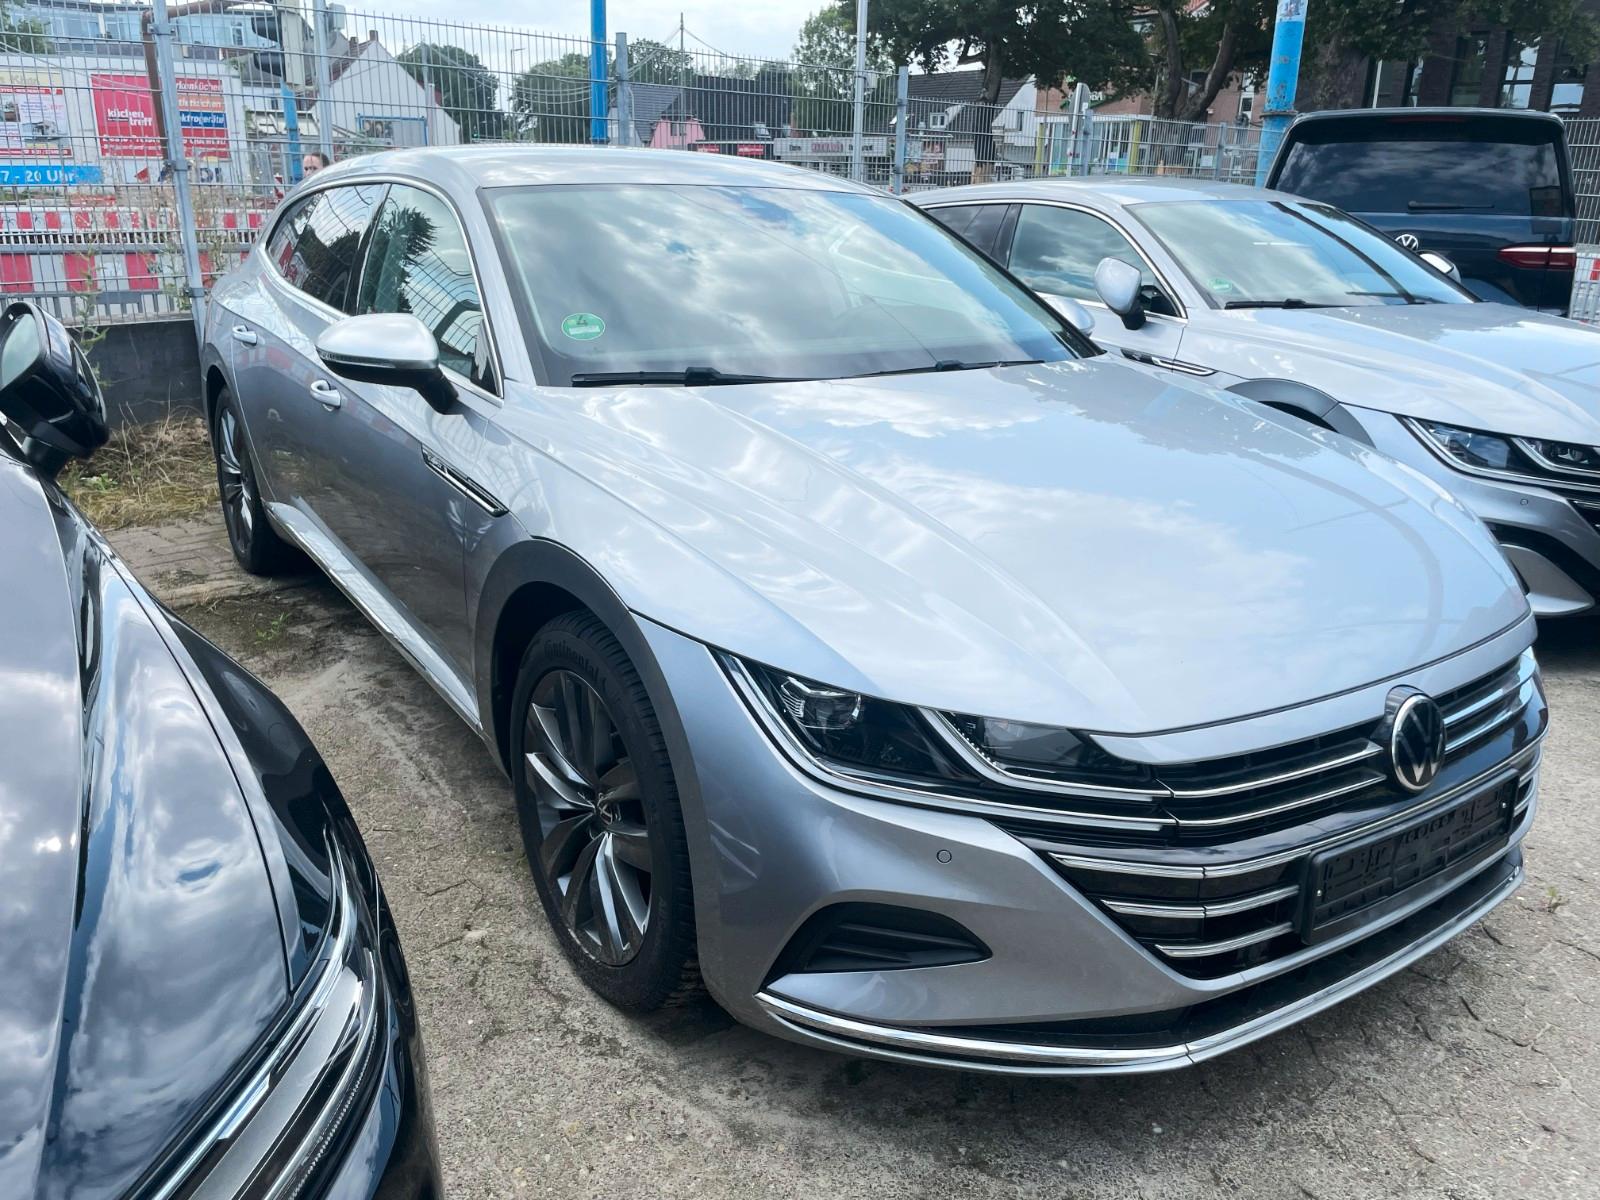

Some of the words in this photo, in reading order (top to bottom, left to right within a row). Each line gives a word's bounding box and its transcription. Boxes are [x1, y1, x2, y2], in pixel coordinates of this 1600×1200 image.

[107, 108, 144, 118] küchen
[130, 117, 153, 126] treff
[25, 170, 42, 182] 20
[46, 170, 74, 182] Uhr
